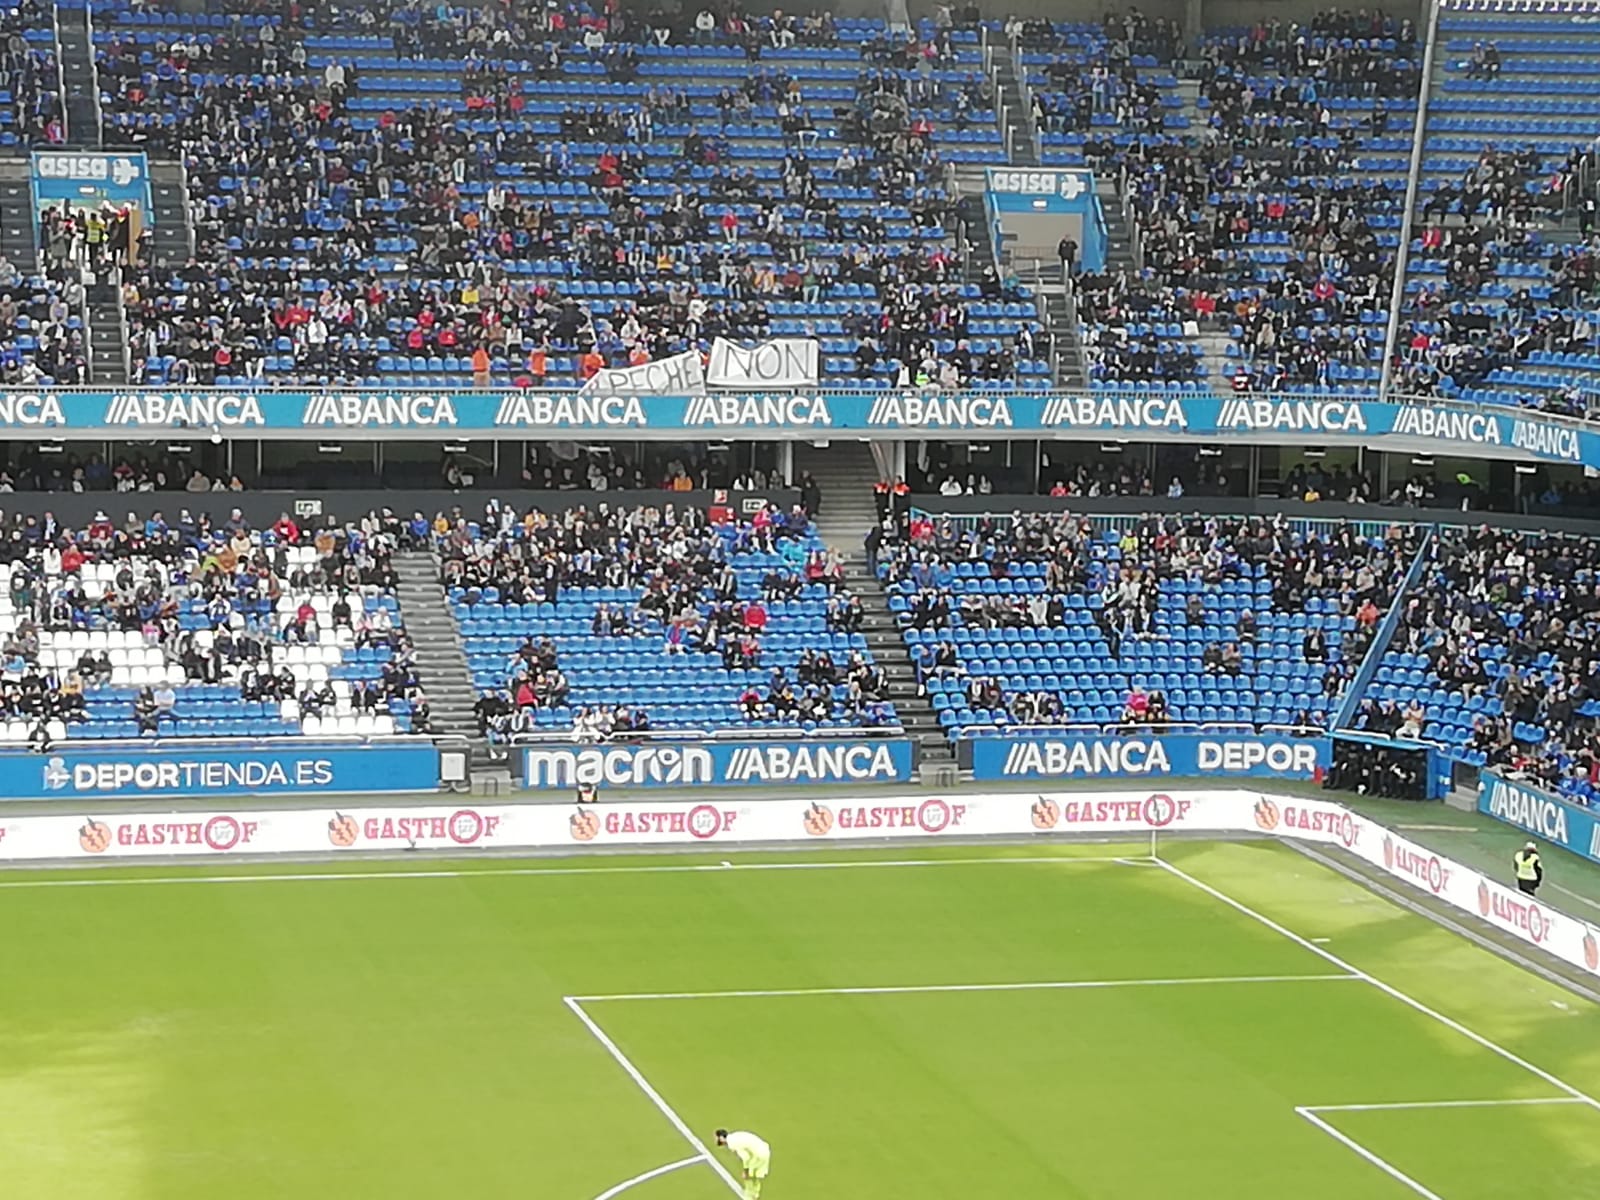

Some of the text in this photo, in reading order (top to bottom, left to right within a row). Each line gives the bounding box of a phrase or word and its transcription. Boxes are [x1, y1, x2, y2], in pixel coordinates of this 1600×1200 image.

[39, 157, 107, 180] asisa
[993, 172, 1056, 194] asisa
[724, 343, 812, 380] NON
[123, 396, 265, 424] ABANCA
[319, 396, 458, 424] ABANCA
[510, 396, 647, 424] ABANCA
[698, 397, 831, 424] ABANCA
[882, 398, 1013, 426] ABANCA
[1055, 399, 1187, 427] ABANCA
[1231, 401, 1367, 431] ABANCA
[1405, 407, 1501, 444] ABANCA
[1515, 422, 1580, 460] ABANCA
[528, 748, 713, 786] macron
[741, 746, 897, 781] ABANCA
[1021, 740, 1171, 773] ABANCA
[1198, 741, 1317, 772] DEPOR
[75, 760, 333, 789] DEPORTIENDA.ES
[363, 809, 500, 844] GASTHOF
[605, 804, 737, 839] GASTHOF
[838, 799, 966, 832] GASTHOF
[1065, 794, 1191, 827] GASTHOF
[1496, 783, 1568, 844] ABANCA
[117, 815, 258, 850] GASTHOF
